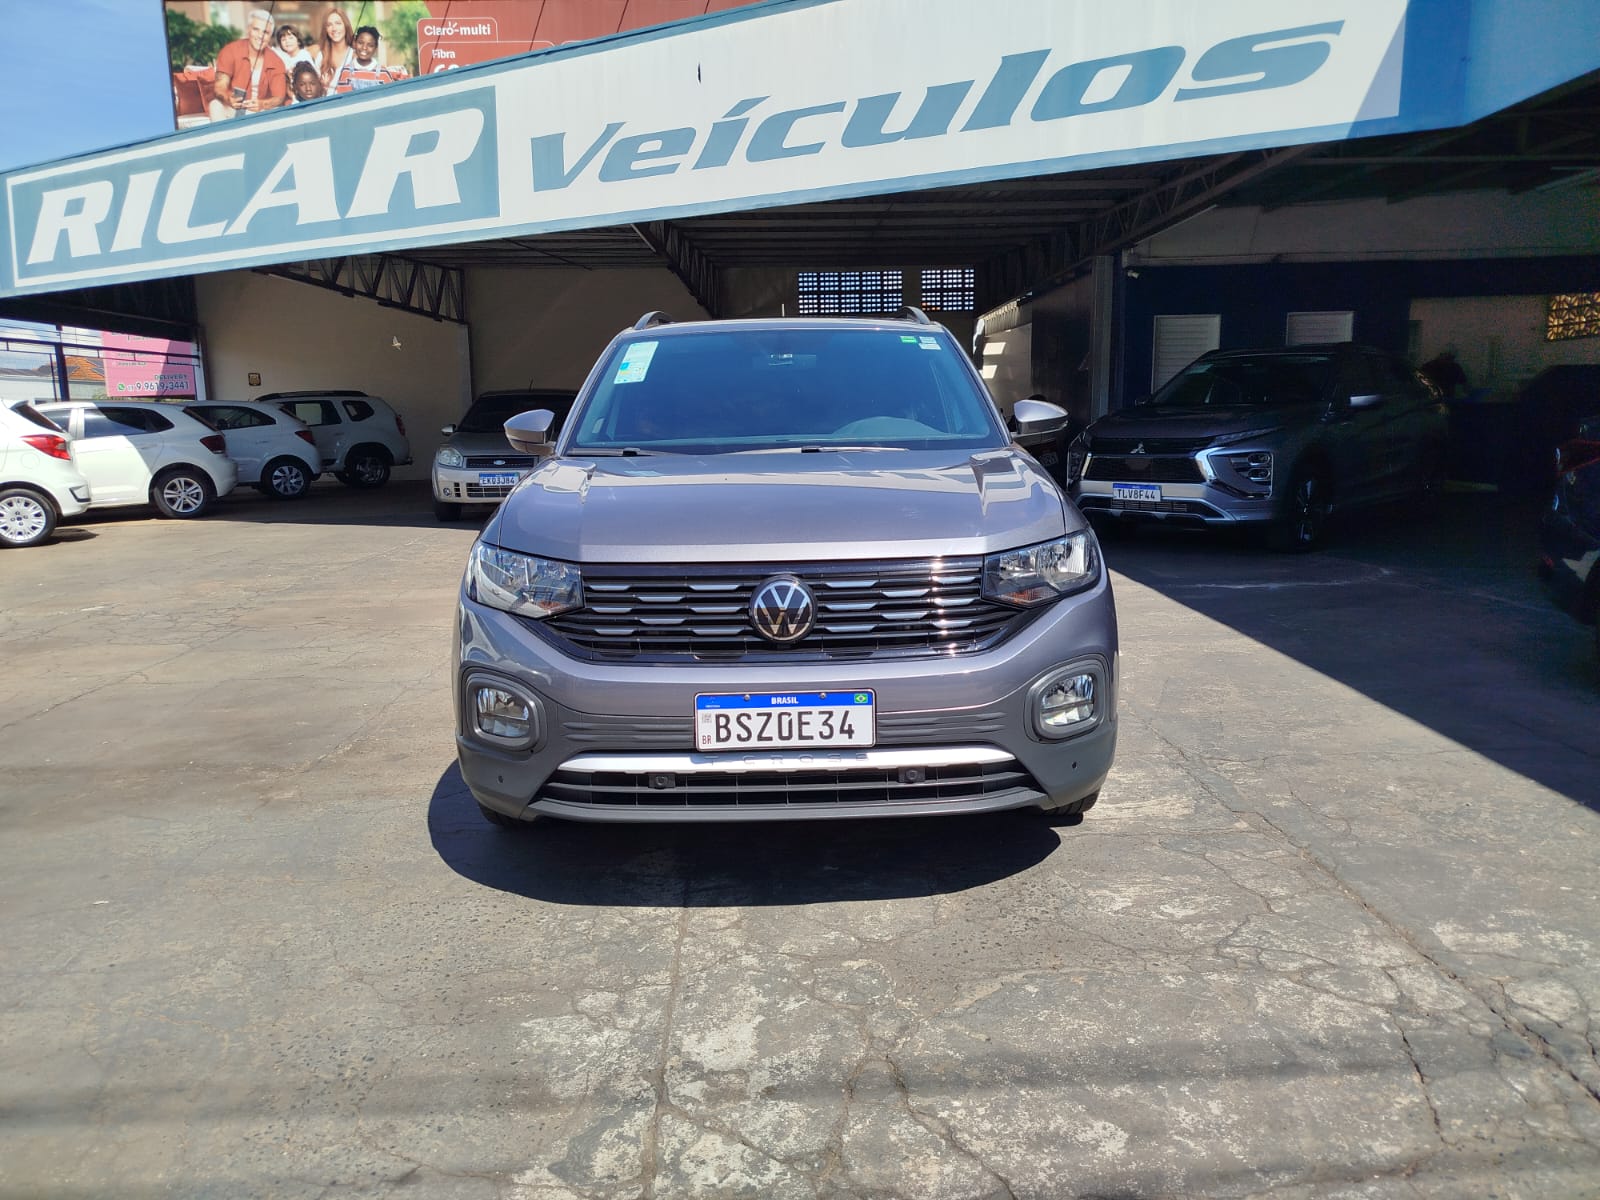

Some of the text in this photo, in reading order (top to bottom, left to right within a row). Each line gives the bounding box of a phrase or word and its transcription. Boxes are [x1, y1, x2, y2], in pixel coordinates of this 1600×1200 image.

[432, 50, 456, 59] Fibra
[26, 20, 1345, 264] RICAR Veículos
[1117, 489, 1155, 499] TLV8F44
[771, 697, 798, 705] BRASIL
[715, 711, 854, 743] BSZ0E34
[702, 735, 711, 744] BR
